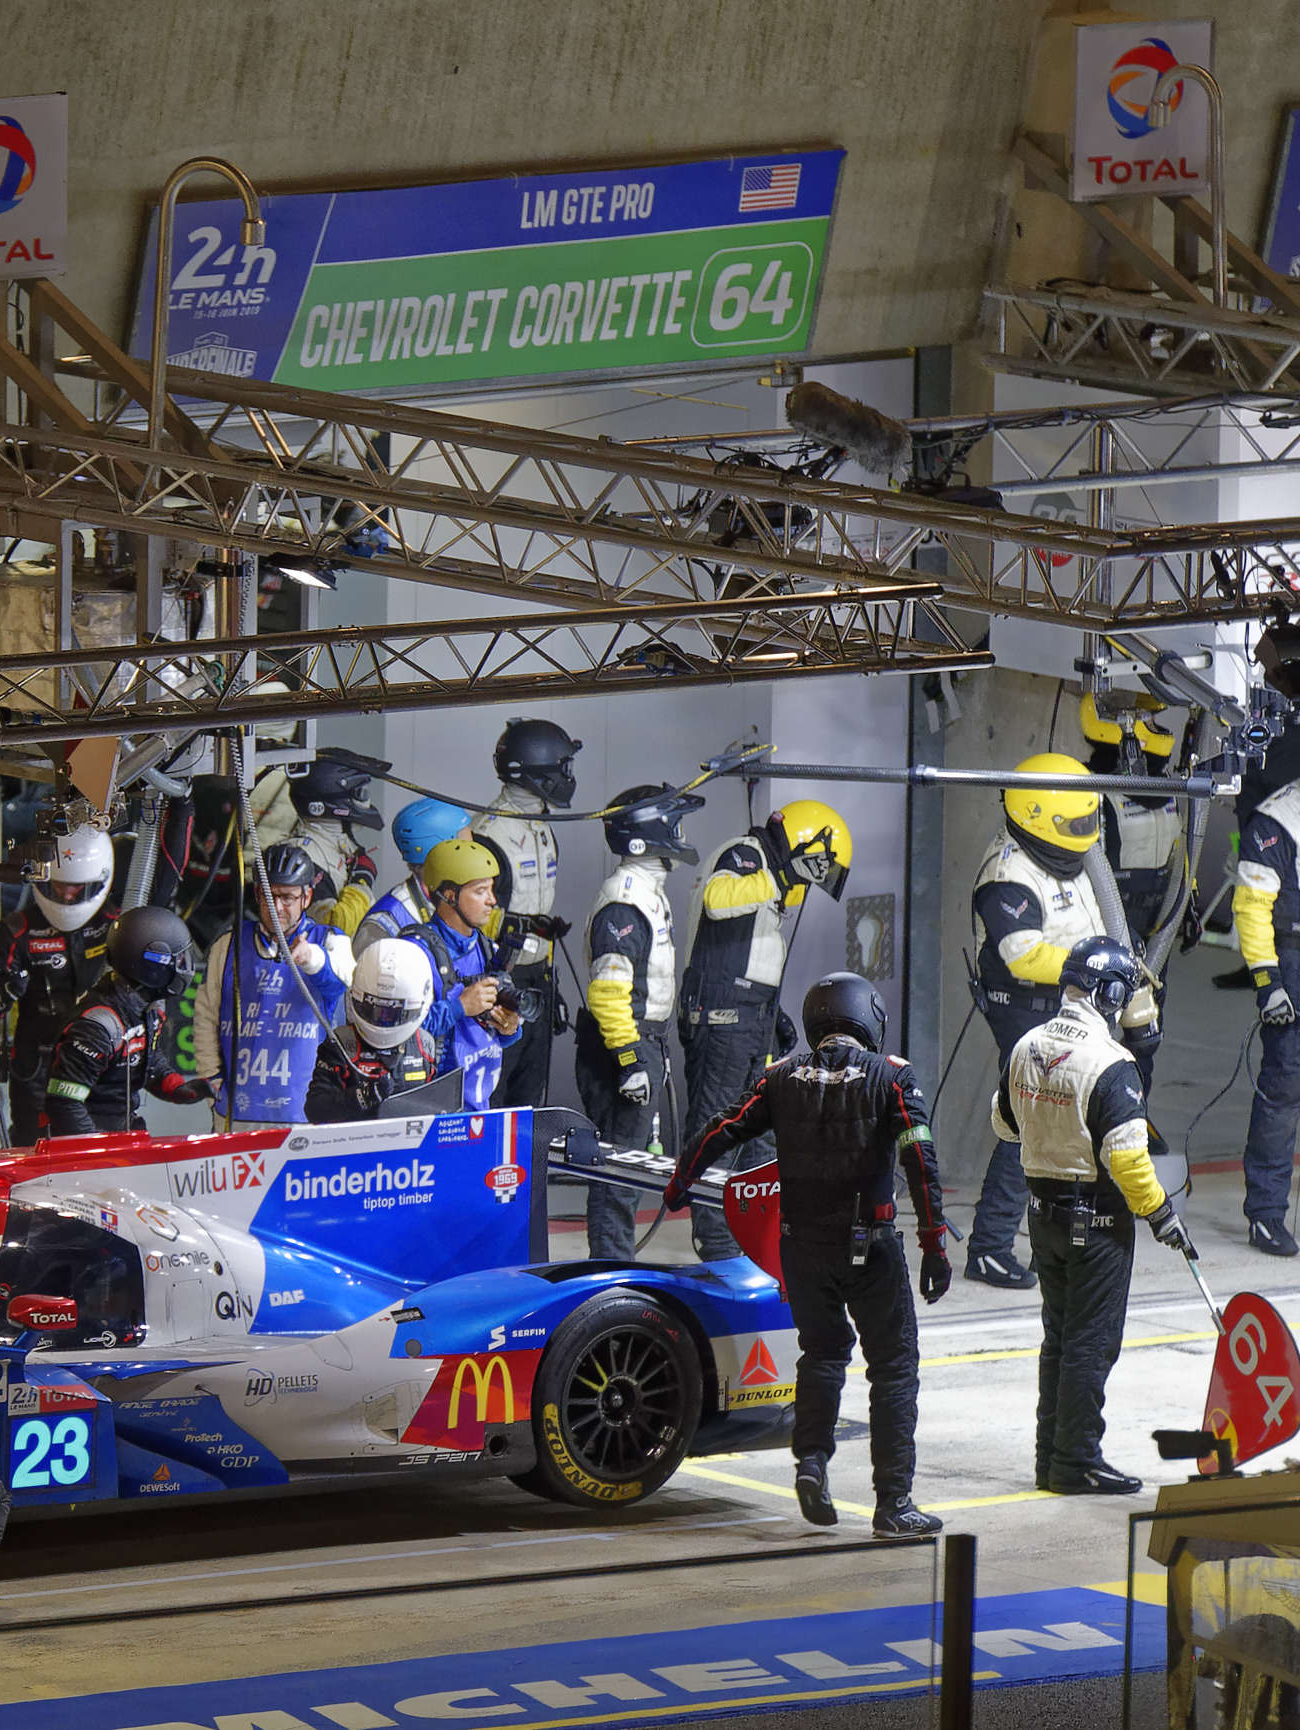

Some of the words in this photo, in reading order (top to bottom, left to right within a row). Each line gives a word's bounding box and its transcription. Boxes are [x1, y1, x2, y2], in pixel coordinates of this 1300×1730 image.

[1087, 155, 1199, 185] TOTAL
[520, 190, 555, 228] LM
[561, 186, 605, 226] GTE
[611, 182, 655, 221] PRO
[168, 292, 197, 310] LE
[197, 287, 266, 309] MANS
[709, 259, 796, 331] 64
[300, 287, 504, 370] CHEVROLET
[507, 268, 694, 350] CORVETTE
[30, 941, 64, 951] TOTAL
[274, 1002, 292, 1019] TV
[277, 1021, 319, 1040] TRACK
[236, 1047, 292, 1087] 344
[284, 1158, 436, 1202] binderholz
[493, 1171, 518, 1186] 1969
[731, 1180, 781, 1200] TOTA
[363, 1196, 396, 1212] tiptop
[398, 1191, 434, 1206] timber
[145, 1250, 211, 1272] onemile
[268, 1288, 306, 1307] DAF
[29, 1311, 77, 1325] TOTAL
[511, 1327, 547, 1340] SERFIM
[1228, 1312, 1295, 1428] 64
[245, 1377, 274, 1397] HD
[277, 1374, 319, 1389] PELLETS
[736, 1387, 794, 1403] DUNLOP
[184, 1432, 223, 1443] ProTech
[11, 1416, 91, 1489] 23
[216, 1443, 244, 1455] HKO
[220, 1455, 261, 1468] GDP
[139, 1481, 181, 1493] DEWESoft
